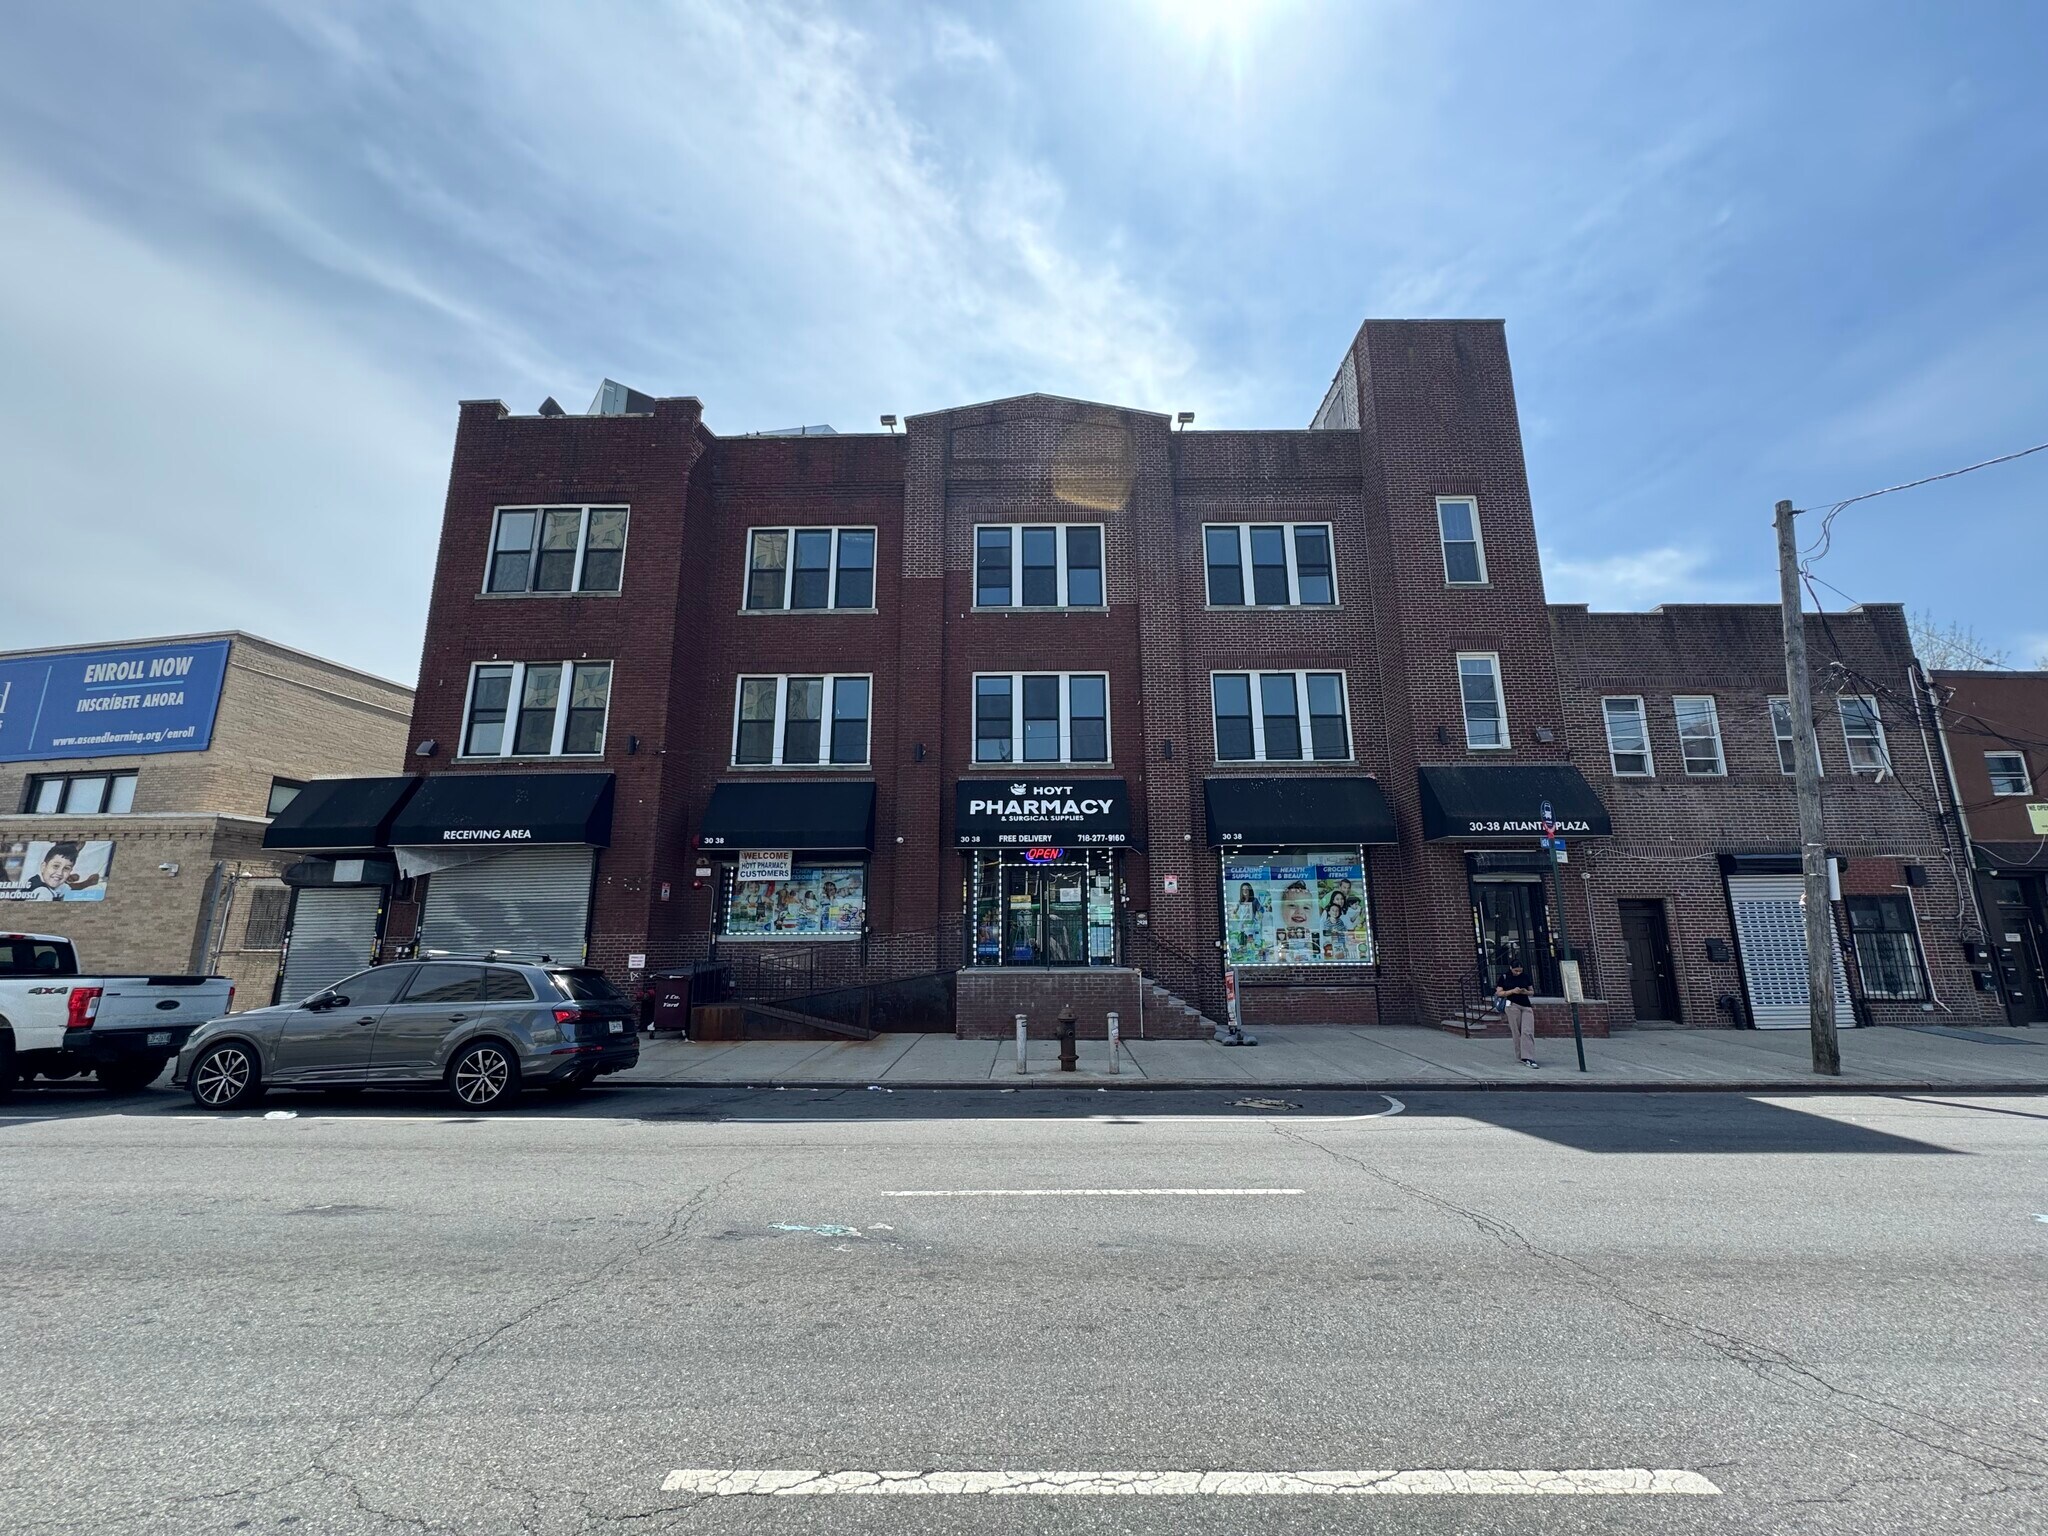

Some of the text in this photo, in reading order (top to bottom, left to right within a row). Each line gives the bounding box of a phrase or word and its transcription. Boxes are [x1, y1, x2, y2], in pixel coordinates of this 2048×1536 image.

[83, 656, 194, 684] ENROLL NOW
[76, 691, 184, 713] INSCRÍBETE AHORA
[53, 726, 196, 747] www.ascendlearning.org/enroll
[1033, 786, 1074, 796] HOYT
[969, 799, 1114, 815] PHARMACY
[1468, 821, 1500, 831] 30-38
[1502, 821, 1547, 831] ATLANT
[1555, 821, 1590, 831] PLAZA
[443, 829, 532, 840] RECEIVING AREA
[998, 834, 1053, 843] FREE DELIVERY
[743, 852, 789, 860] WELCOME
[1028, 848, 1060, 860] OPEN
[740, 869, 789, 878] CUSTOMERS
